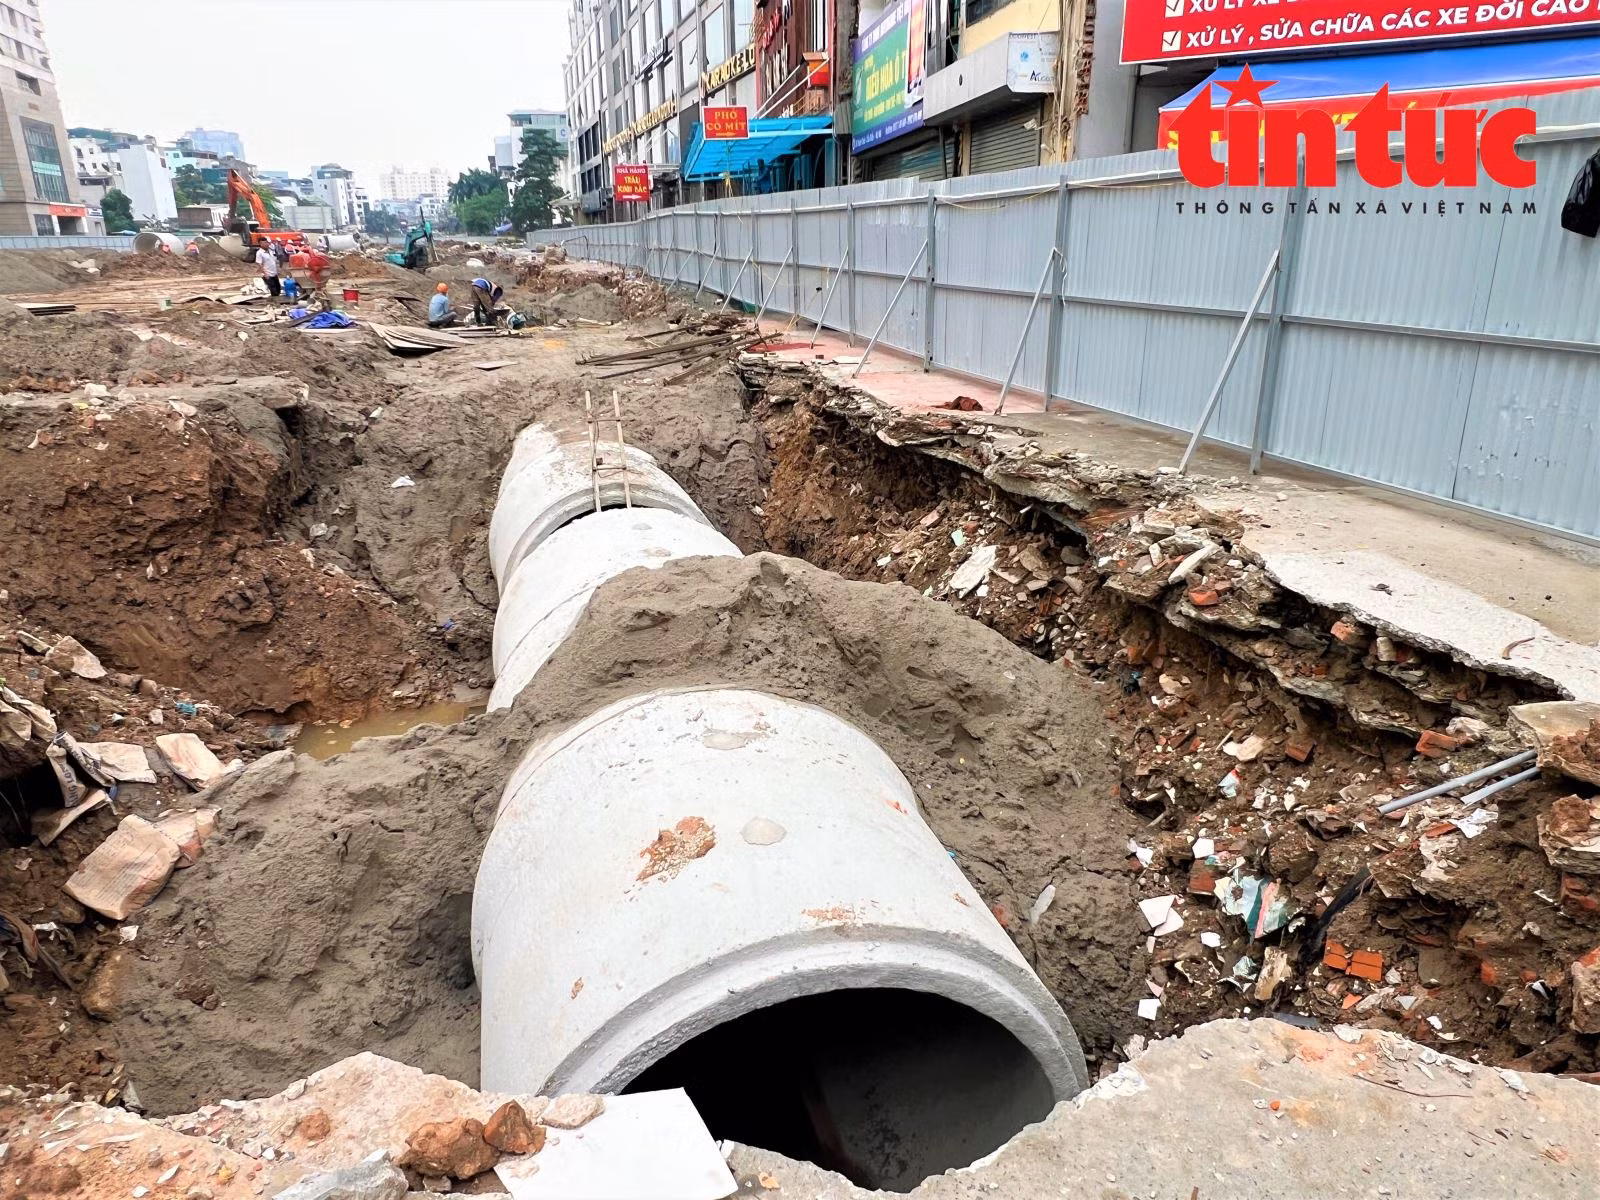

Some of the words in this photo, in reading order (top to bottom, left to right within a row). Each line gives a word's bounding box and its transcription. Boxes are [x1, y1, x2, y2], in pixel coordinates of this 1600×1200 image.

[1186, 26, 1216, 48] XỬ
[1220, 24, 1244, 45] LÝ
[1260, 18, 1304, 41] SỬA
[1310, 13, 1375, 36] CHỮA
[1381, 8, 1431, 31] CÁC
[1436, 7, 1469, 26] XE
[1475, 0, 1524, 22] ĐỜI
[1531, 0, 1590, 16] CAO
